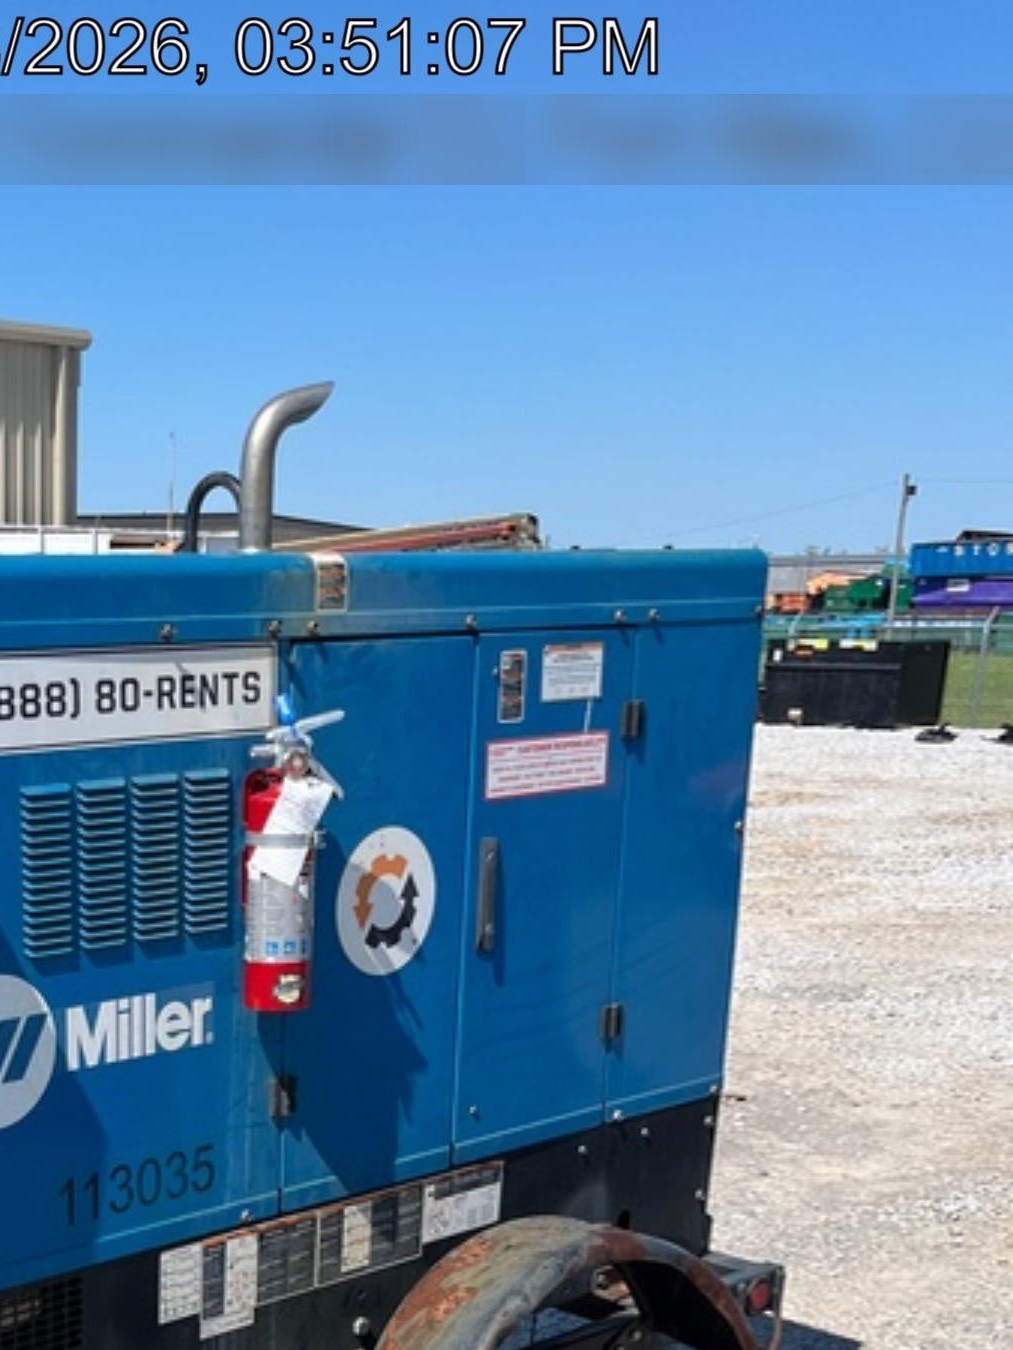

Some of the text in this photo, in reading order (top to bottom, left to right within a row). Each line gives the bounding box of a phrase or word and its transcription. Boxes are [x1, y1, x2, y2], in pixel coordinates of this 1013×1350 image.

[95, 671, 261, 714] 80-RENTS
[65, 992, 213, 1072] Miller
[59, 1143, 217, 1226] 113035
